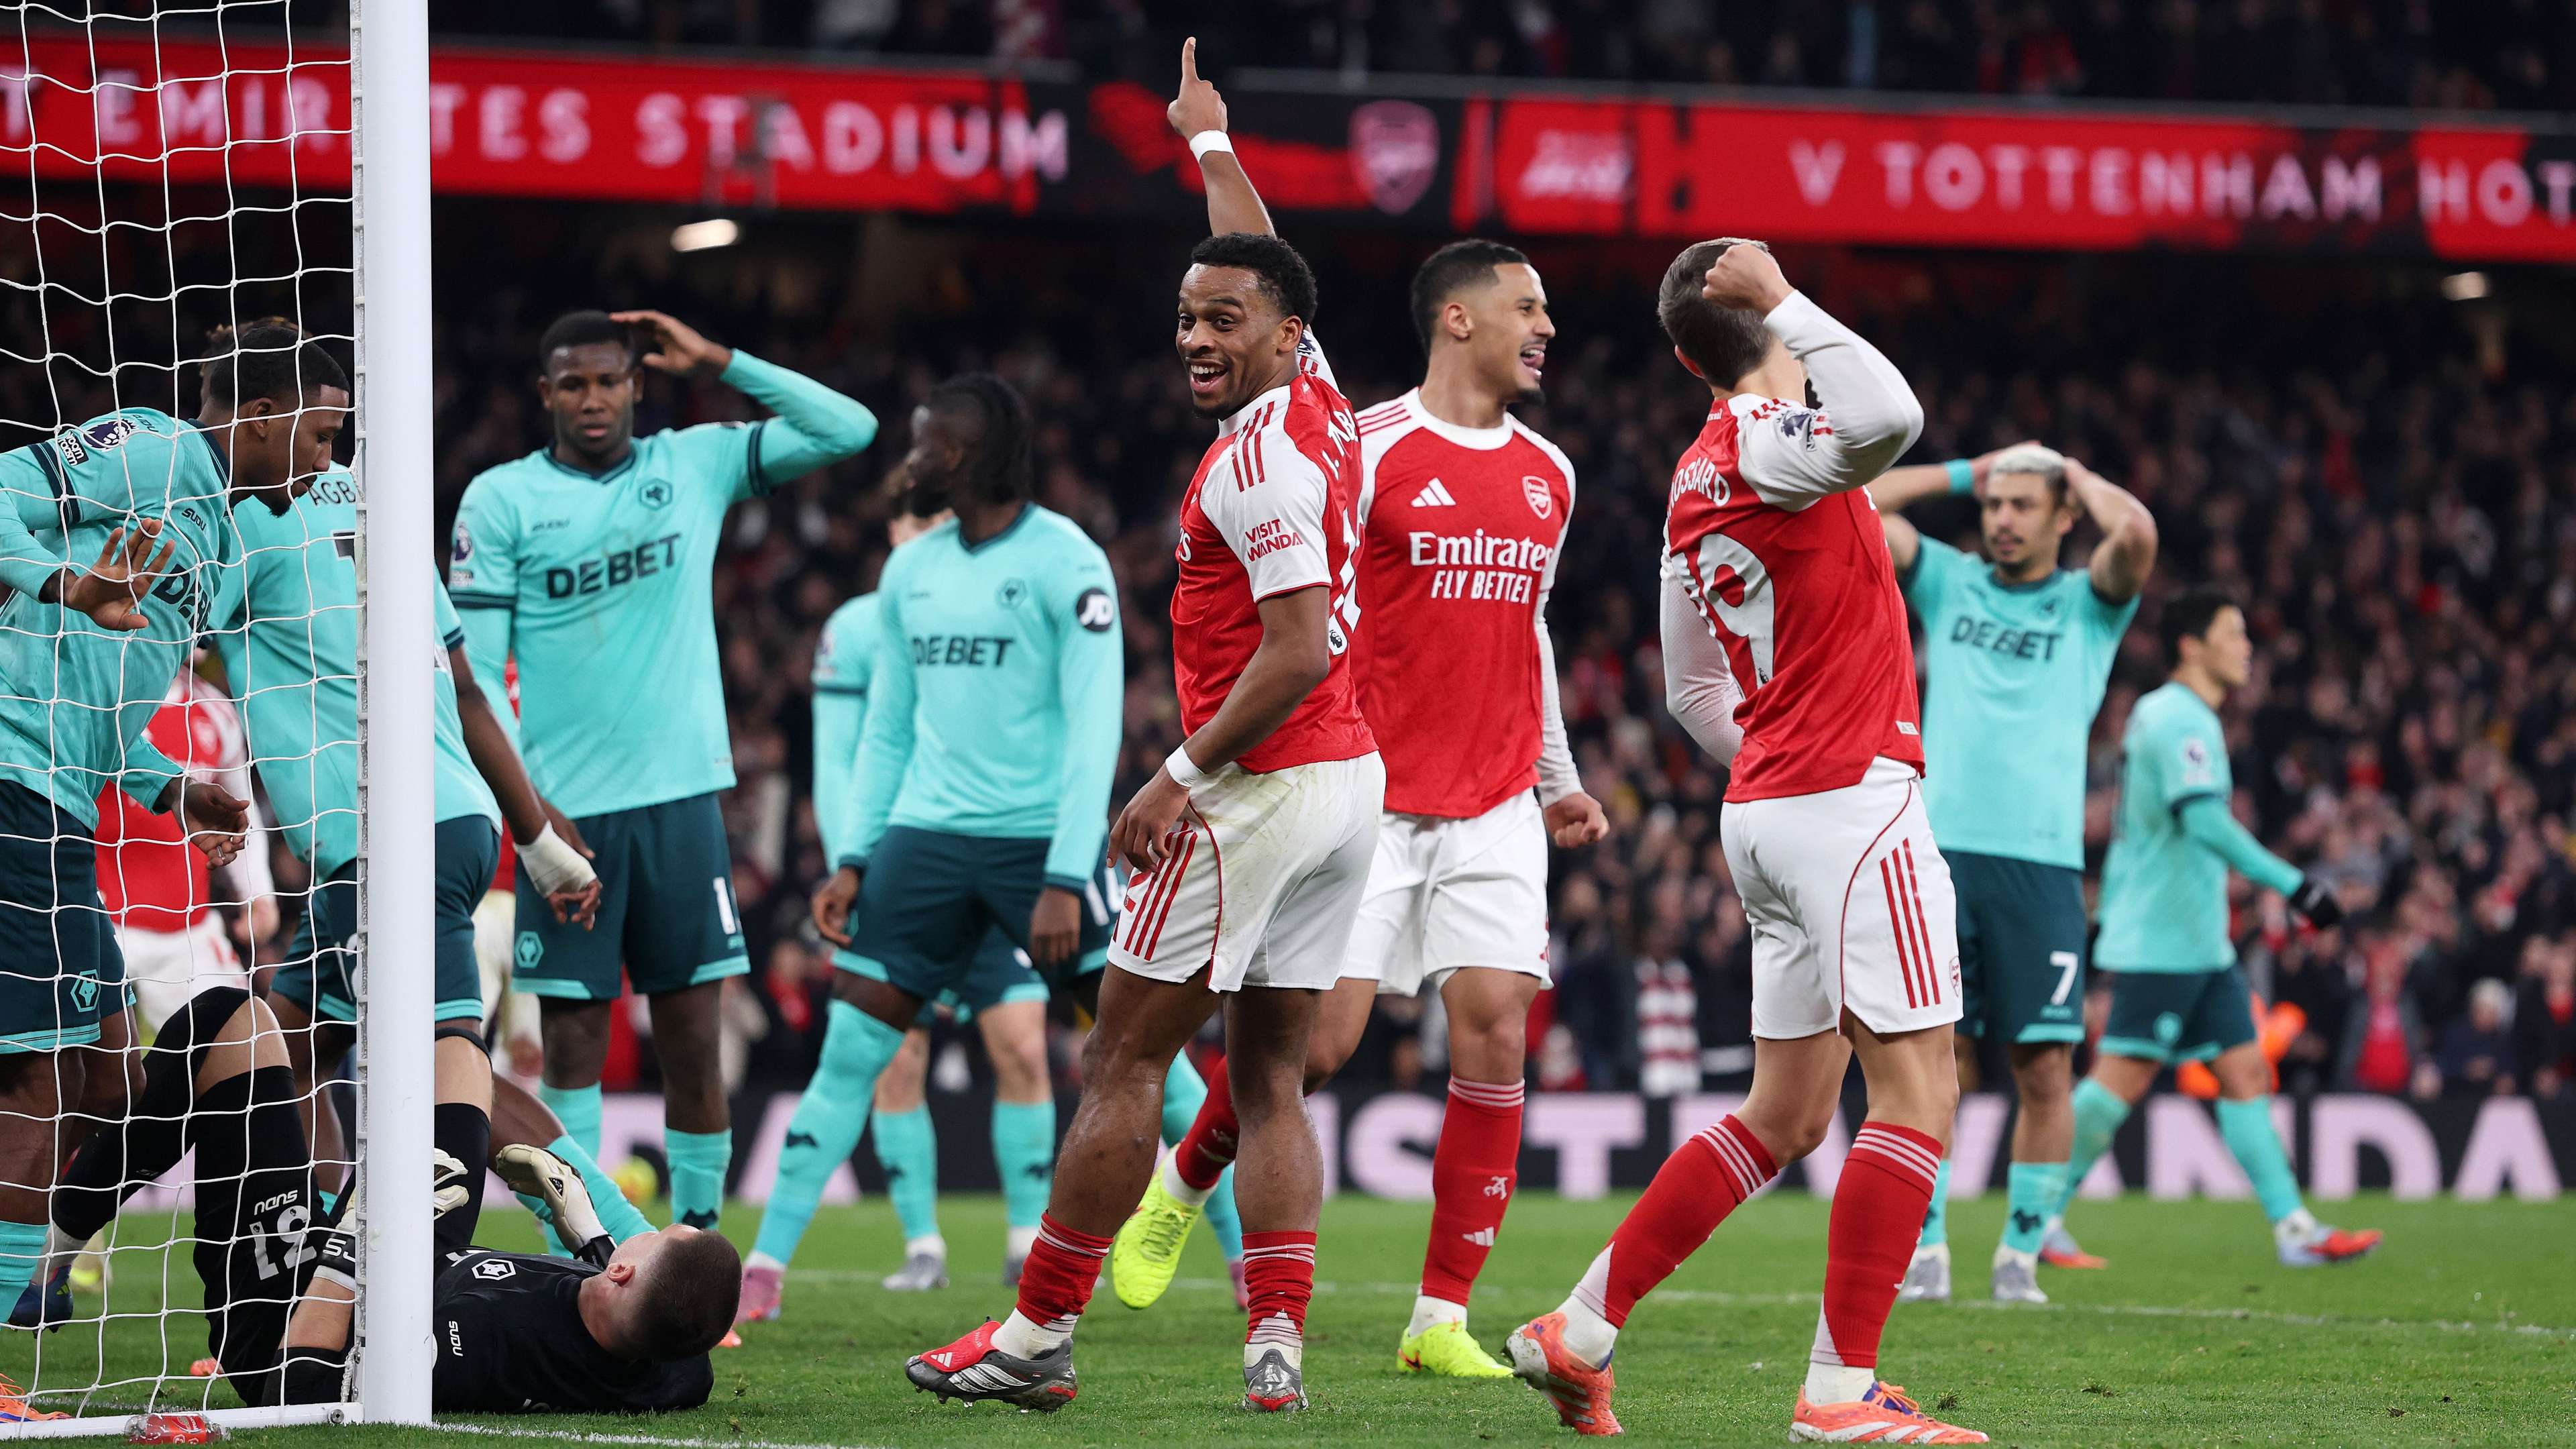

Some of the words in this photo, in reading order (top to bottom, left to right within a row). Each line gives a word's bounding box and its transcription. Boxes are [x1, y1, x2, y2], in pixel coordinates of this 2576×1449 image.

[96, 70, 592, 165] EMIRTES
[635, 91, 1069, 181] STADIUM
[1787, 138, 1846, 207] V
[1881, 141, 2382, 223] TOTTENHAM
[2420, 158, 2576, 228] HOT
[58, 439, 78, 466] racsm
[1667, 457, 1731, 521] OSSARD
[182, 508, 207, 531] SUDU
[1245, 519, 1281, 543] VISIT
[1246, 532, 1303, 562] WANDA
[547, 533, 681, 599] DEBET
[1430, 570, 1468, 599] FLY
[913, 635, 1015, 667] DEBET
[1951, 614, 2063, 661] DEBET
[2049, 950, 2078, 1006] 7
[254, 1189, 298, 1216] SUDU
[449, 1320, 464, 1356] SUDU
